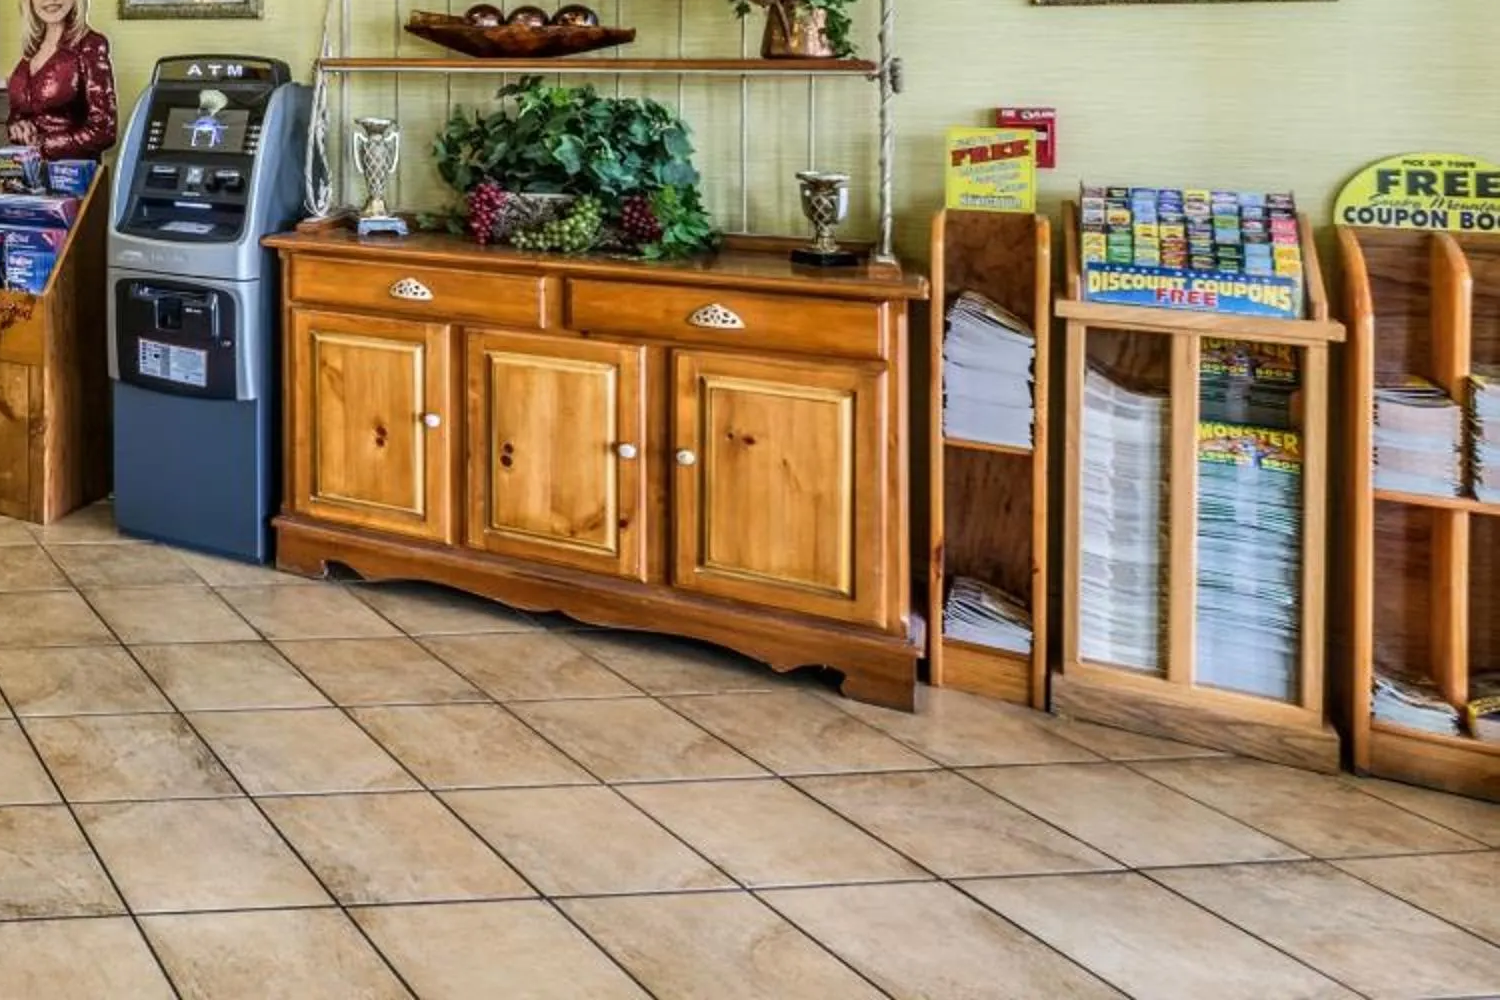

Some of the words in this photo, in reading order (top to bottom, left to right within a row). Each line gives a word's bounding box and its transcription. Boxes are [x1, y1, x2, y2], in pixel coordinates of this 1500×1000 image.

[187, 63, 243, 77] ATM
[1376, 168, 1500, 198] FREE
[1343, 206, 1449, 228] COUPON
[1460, 210, 1500, 230] BO
[1088, 270, 1188, 293] DISCOUNT
[1192, 278, 1293, 311] COUPONS
[1156, 288, 1217, 306] FREE
